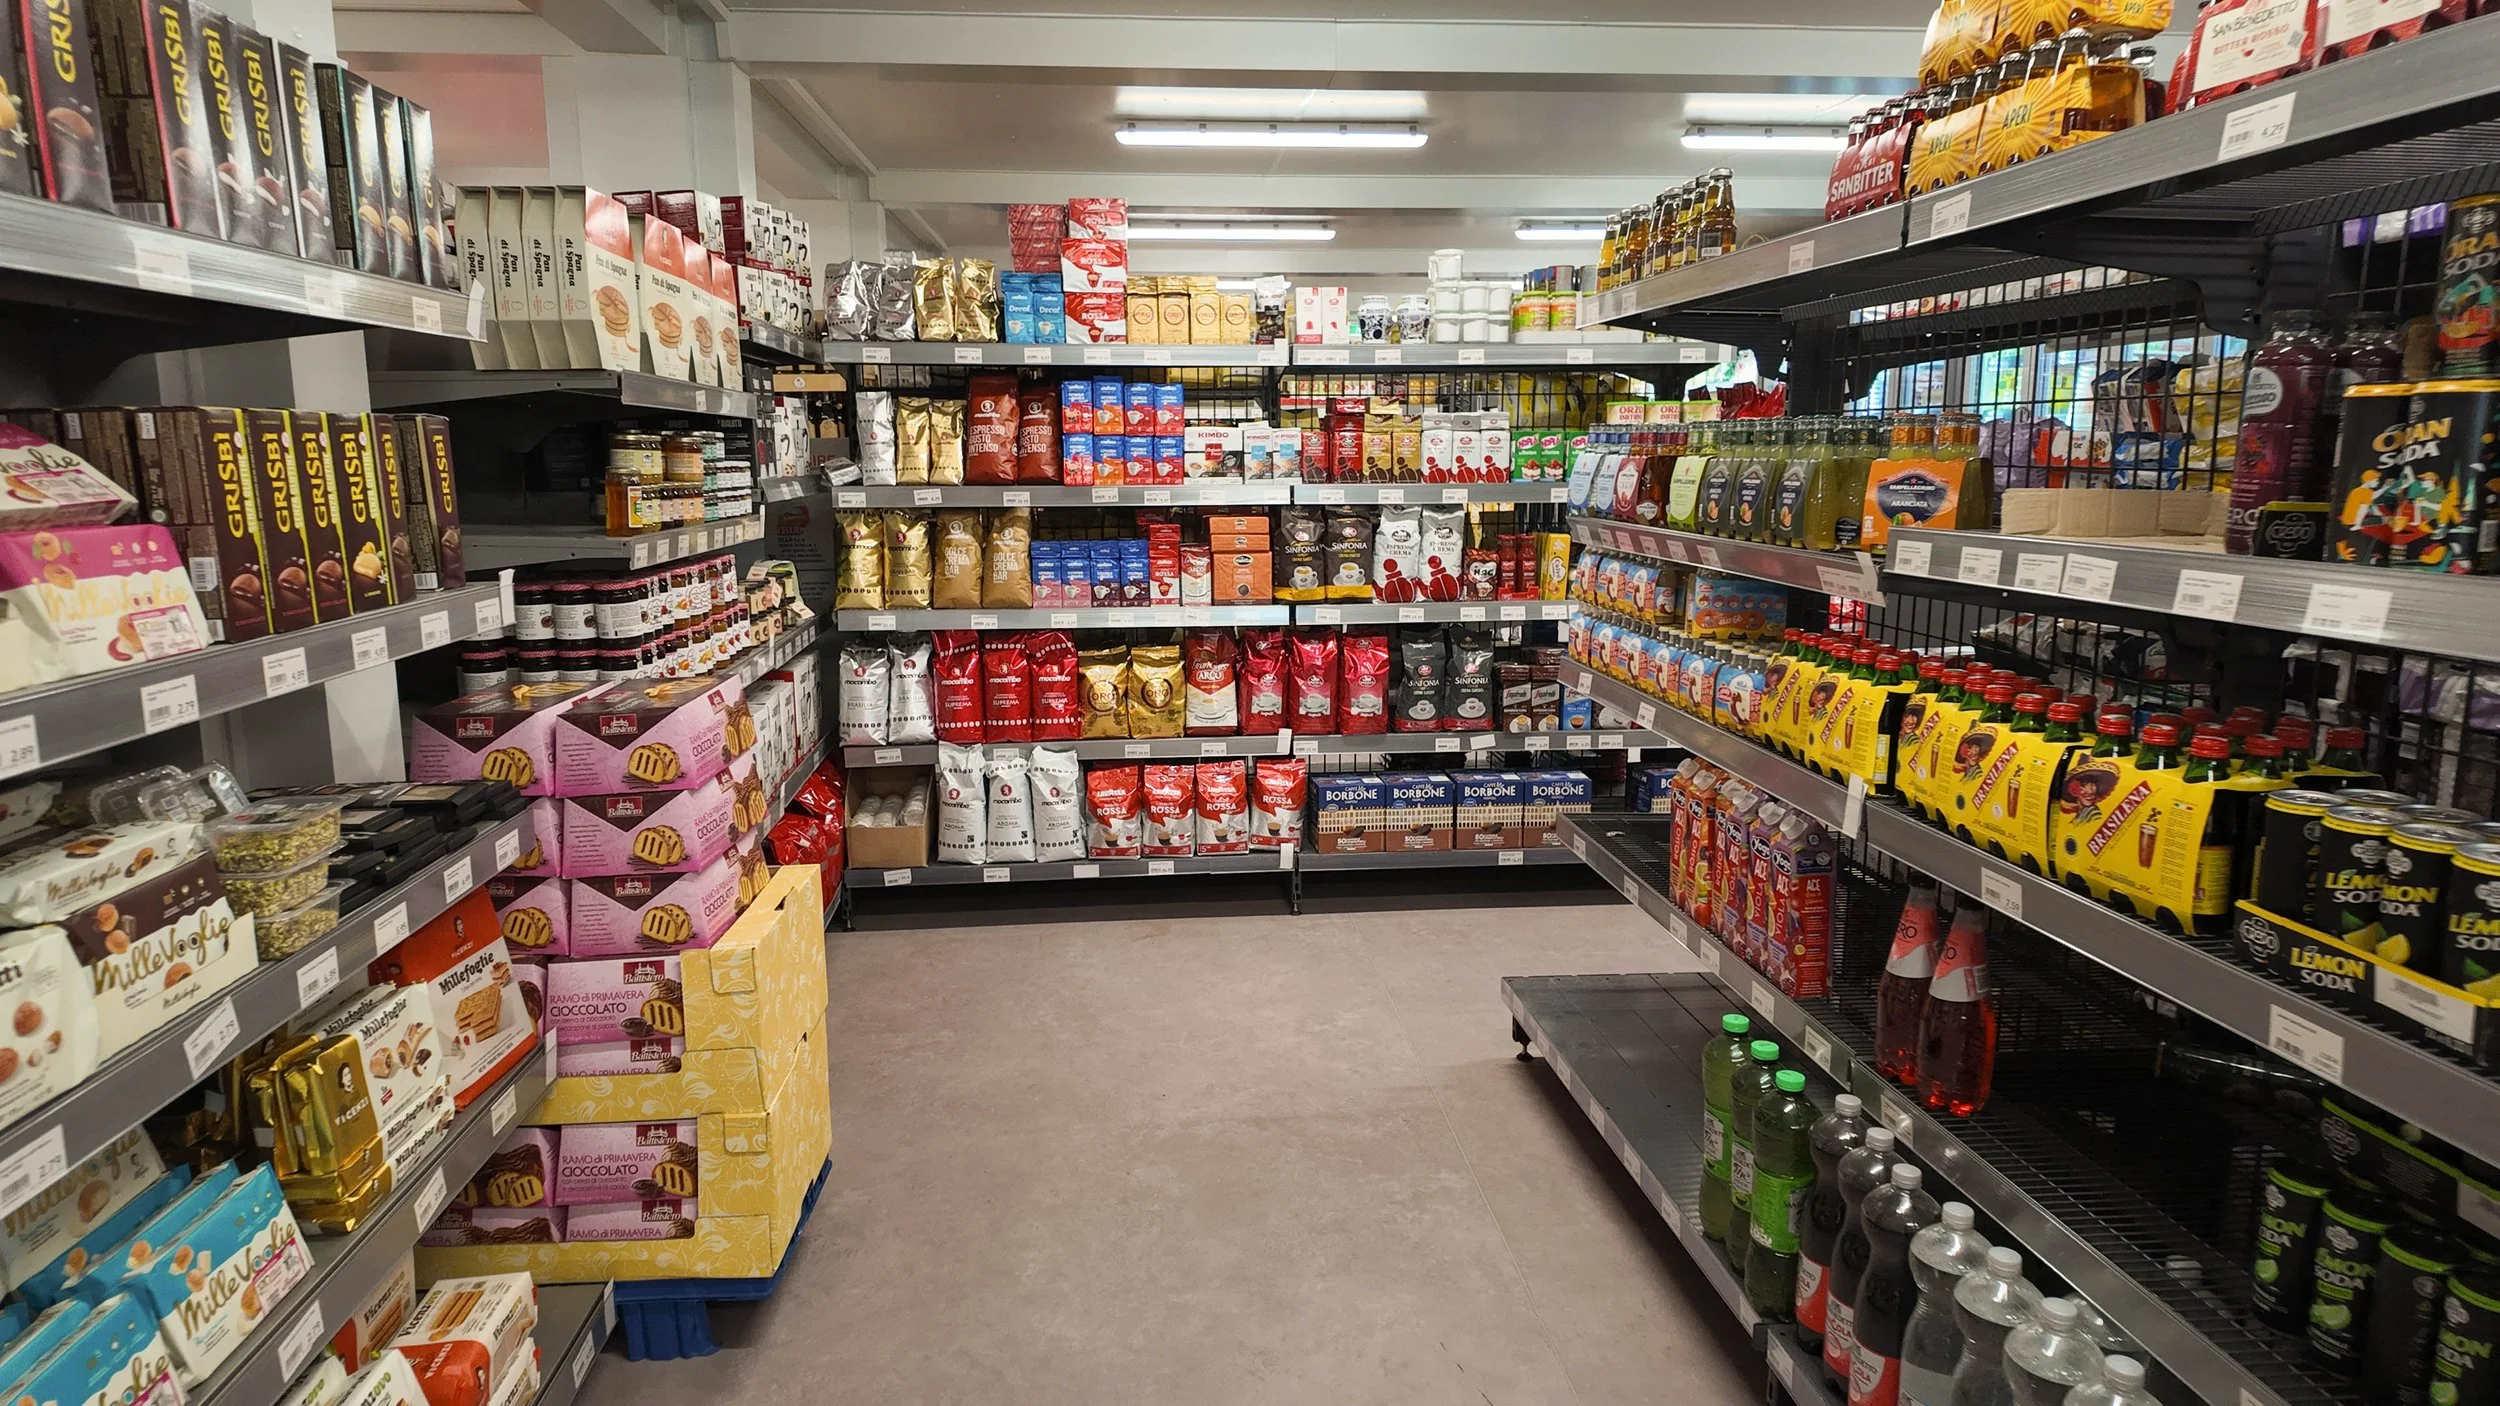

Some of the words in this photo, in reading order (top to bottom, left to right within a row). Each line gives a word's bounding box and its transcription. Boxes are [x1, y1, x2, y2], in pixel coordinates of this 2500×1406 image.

[1831, 161, 1895, 203] SANBITTER
[467, 239, 476, 249] di
[501, 239, 509, 249] di
[533, 239, 542, 249] di
[565, 238, 574, 249] di
[477, 253, 485, 272] Pan
[510, 253, 519, 273] Pan
[534, 251, 544, 287] Spagna
[542, 253, 551, 273] Pan
[566, 250, 576, 287] Spagna
[574, 253, 583, 272] Pan
[501, 251, 512, 288] Spagna
[665, 280, 681, 295] Spagna
[1008, 304, 1031, 314] Decaf
[1039, 305, 1061, 314] Decaf
[969, 425, 1005, 434] ESPRESSO
[1020, 426, 1052, 435] ESPRESSO
[1284, 544, 1321, 554] SINFONIA
[1332, 541, 1367, 551] SINFONIA
[993, 571, 1008, 580] BAR
[941, 677, 974, 686] mocambo
[989, 676, 1021, 685] mocambo
[1408, 679, 1439, 687] SINFONIA
[1455, 676, 1488, 686] SINFONIA
[1820, 687, 1854, 745] BRASILENA
[601, 725, 638, 736] Battistero
[1971, 742, 2019, 811] BRASILENA
[1325, 788, 1378, 801] BORBONE
[1393, 787, 1445, 799] BORBONE
[1464, 786, 1516, 798] BORBONE
[1532, 784, 1584, 796] BORBONE
[1206, 803, 1237, 811] ROSSA
[1263, 796, 1293, 805] ROSSA
[608, 807, 643, 818] Battistero
[1097, 808, 1127, 816] ROSSA
[1150, 806, 1181, 814] ROSSA
[2087, 780, 2153, 857] BRASILENA
[698, 813, 730, 840] CIOCCOLATO
[1752, 837, 1771, 858] Yoga
[1689, 838, 1698, 874] ROSSO
[1772, 851, 1791, 873] Yoga
[1754, 858, 1768, 880] ACE
[616, 886, 653, 896] Battistero
[1776, 875, 1789, 895] ACE
[1807, 879, 1821, 892] ACE
[704, 894, 735, 918] CIOCCOLATO
[1754, 882, 1765, 919] VIOLA
[1775, 897, 1786, 935] VIOLA
[2290, 946, 2366, 980] LEMON
[437, 951, 495, 996] Millefoglie
[624, 973, 665, 984] Battistero
[2300, 968, 2356, 993] SODA
[551, 993, 580, 1003] RAMO
[581, 992, 590, 1002] di
[591, 990, 645, 1001] PRIMAVERA
[550, 1003, 627, 1017] CIOCCOLATO
[360, 996, 409, 1041] Millefoglie
[630, 1050, 671, 1061] Battistero
[636, 1135, 677, 1147] Battistero
[562, 1154, 591, 1165] RAMO
[594, 1153, 603, 1163] di
[604, 1151, 657, 1163] PRIMAVERA
[562, 1164, 639, 1177] CIOCCOLATO
[642, 1211, 682, 1222] Battistero
[569, 1229, 600, 1239] RAMO
[600, 1228, 609, 1238] di
[609, 1227, 663, 1237] PRIMAVERA
